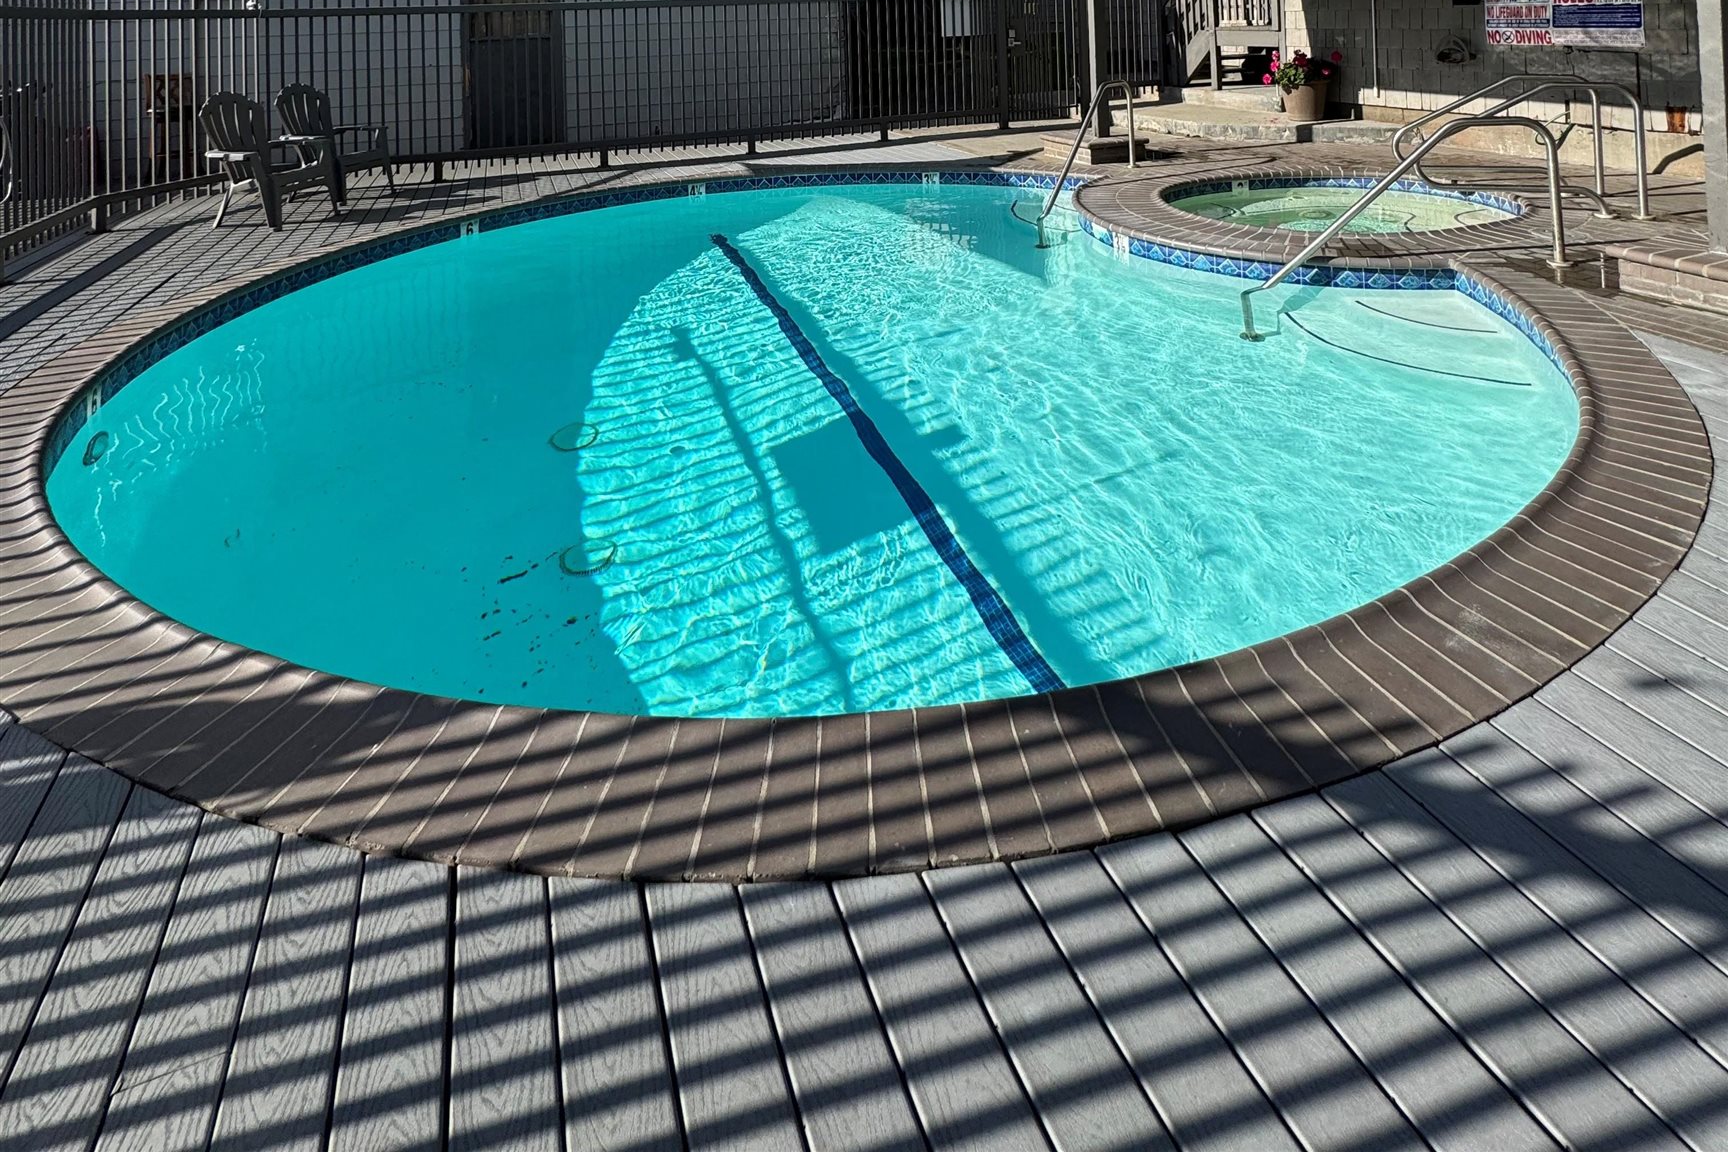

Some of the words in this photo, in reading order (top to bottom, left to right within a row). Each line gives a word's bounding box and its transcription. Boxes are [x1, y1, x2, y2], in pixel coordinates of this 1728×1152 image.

[1487, 5, 1494, 19] NO
[1496, 5, 1523, 19] LIFEGUARD
[1525, 5, 1532, 18] ON
[1534, 4, 1548, 18] DUTY
[1487, 30, 1502, 45] NO
[1515, 30, 1552, 44] DIVING
[466, 222, 474, 236] 6
[91, 386, 98, 416] 6
